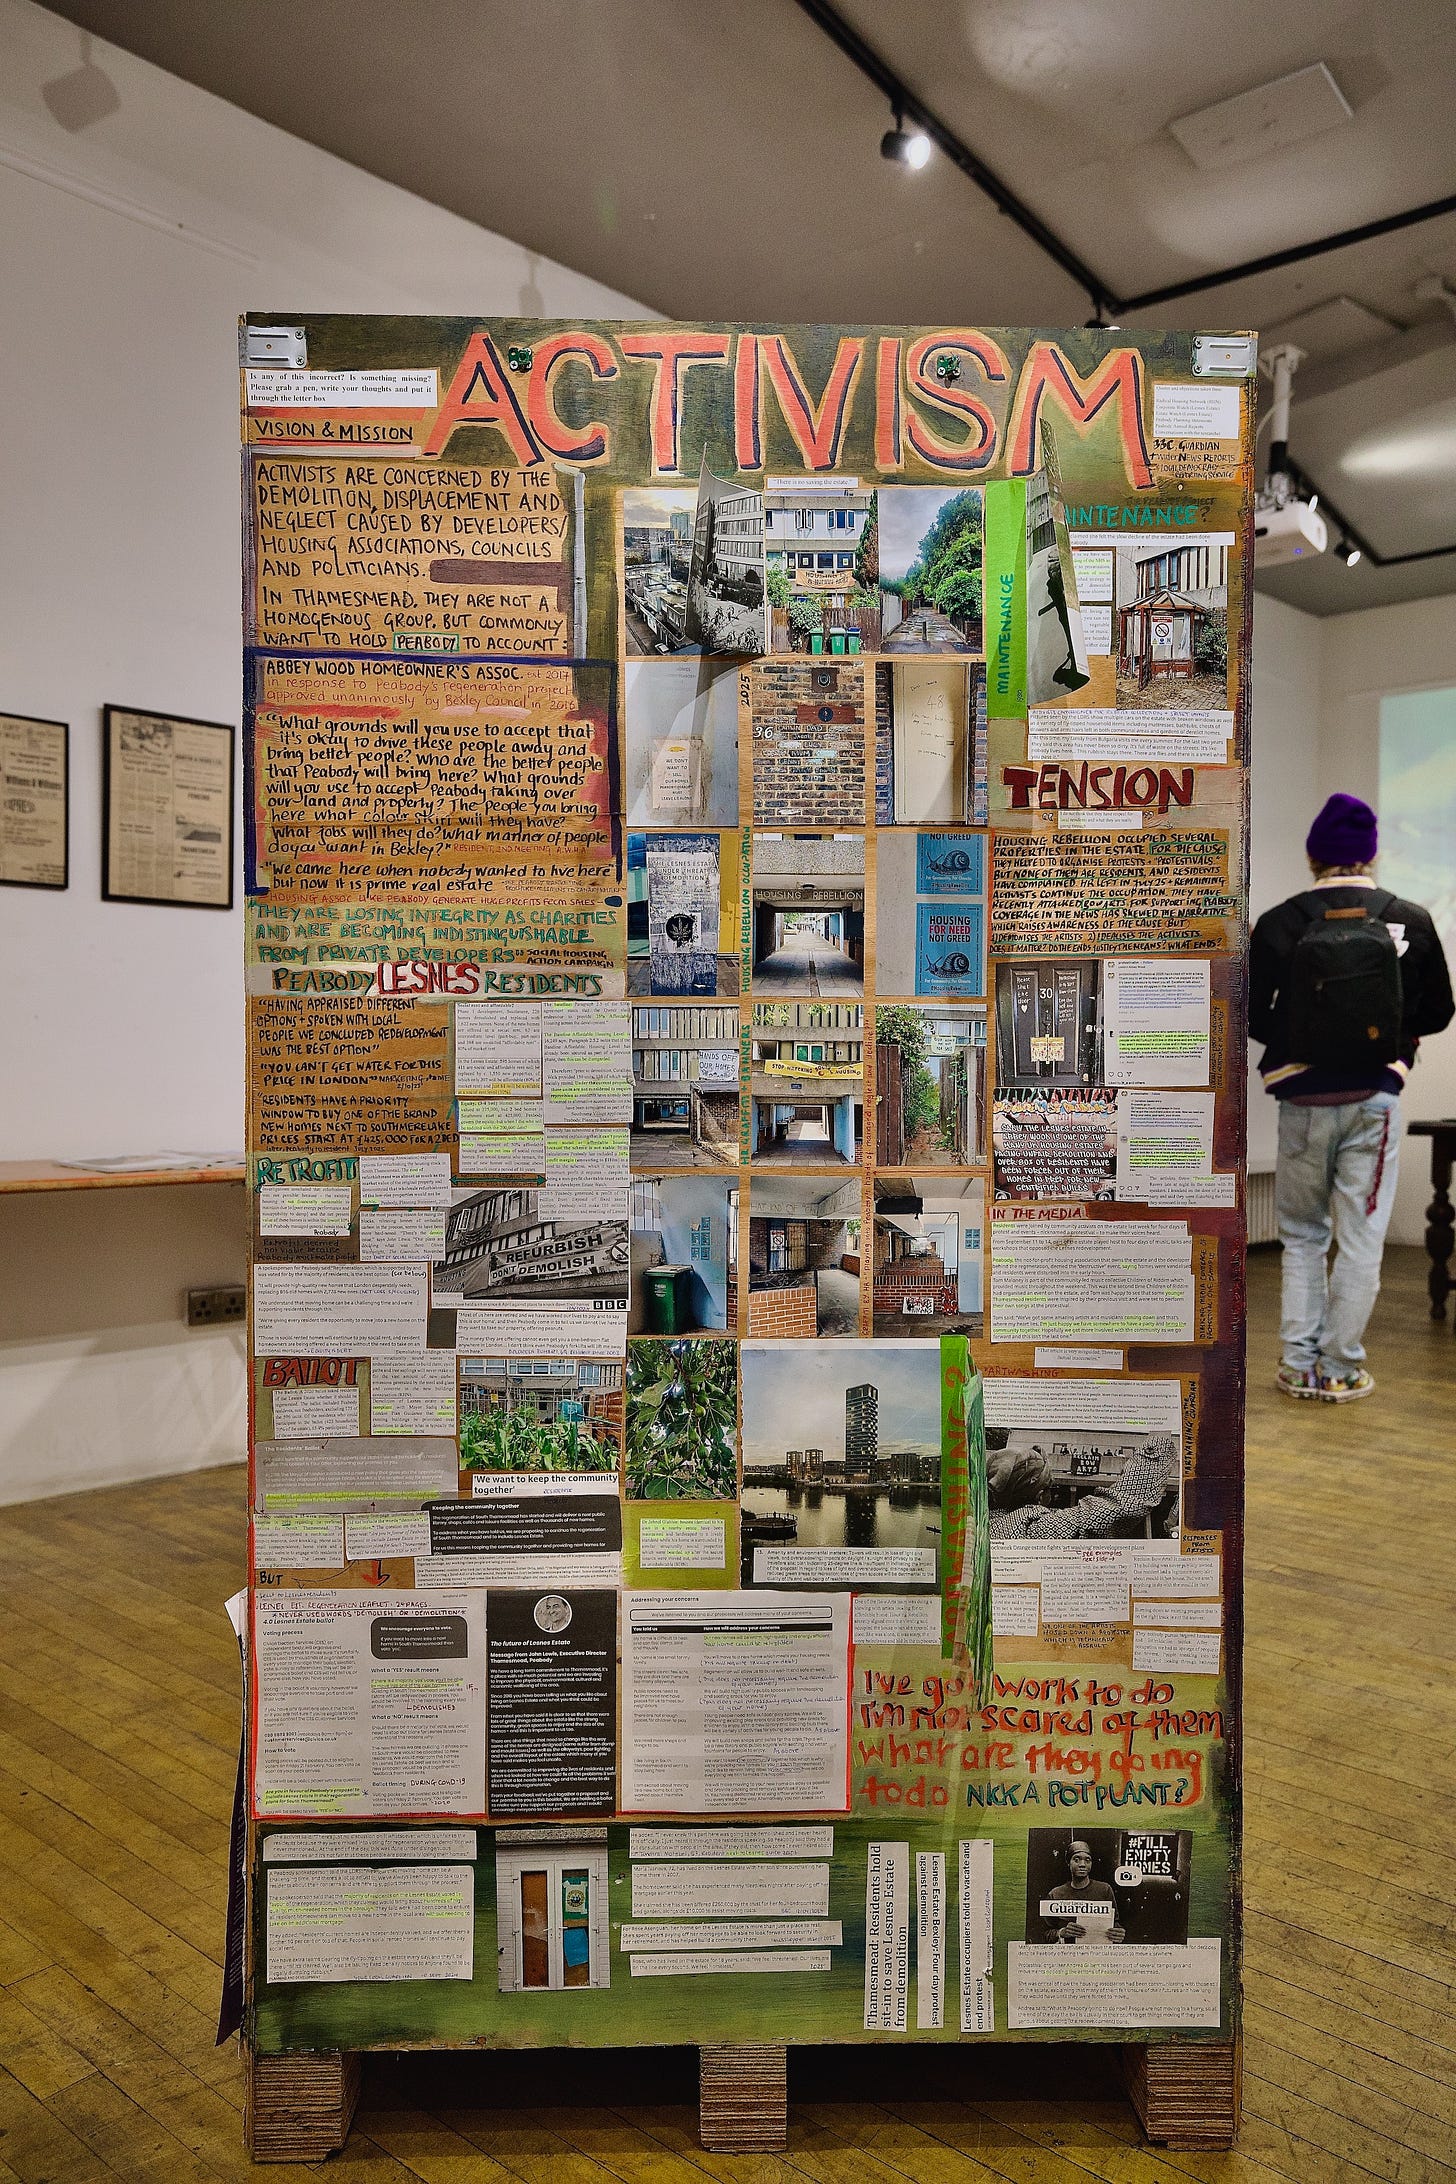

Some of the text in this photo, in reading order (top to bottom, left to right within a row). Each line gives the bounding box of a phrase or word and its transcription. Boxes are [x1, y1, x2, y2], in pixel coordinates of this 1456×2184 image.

[402, 375, 431, 383] missing?
[251, 394, 279, 402] through
[423, 332, 1156, 489] ACTIVISM
[255, 419, 413, 440] VISION & MISSION
[258, 463, 549, 488] ACTIVISTS ARE CONCERNED BY THE
[258, 485, 560, 511] DEMOLITION, DISPLACEMENT AND
[261, 535, 551, 557] HOUSING ASSOCIATIONS, COUNCILS
[996, 573, 1015, 695] MAINTENANCE
[267, 660, 523, 680] ABBEY WOOD HOMEOWNER'S ASSOC.
[740, 674, 750, 708] 2025
[753, 726, 773, 738] 36
[1004, 760, 1194, 815] TENSION
[994, 833, 1219, 847] HOUSING REBELLION OCCUPIED SEVERAL
[756, 890, 863, 901] HOUSING REBELLION
[305, 908, 339, 919] ARE
[346, 908, 404, 925] LOSING
[410, 908, 500, 926] INTEGRITY
[505, 910, 526, 923] AS
[530, 911, 616, 925] CHARITIES
[741, 889, 751, 944] REBELLION
[930, 916, 970, 925] HOUSING
[929, 925, 970, 934] FOR NEED
[929, 934, 970, 942] NOT GREED
[273, 961, 603, 997] PEABODY LESNES RESIDENTS
[741, 947, 751, 992] HOUSING
[1040, 988, 1053, 999] 30
[700, 1051, 738, 1062] HANDS OFF
[700, 1062, 714, 1070] OUR
[257, 1156, 359, 1185] RETROFIT
[992, 1207, 1082, 1219] IN THE MEDIA
[506, 1233, 603, 1263] REFURBISH
[492, 1256, 595, 1279] DON'T DEMOLISH
[593, 1300, 627, 1309] BBC
[263, 1358, 367, 1387] BALLOT
[474, 1475, 491, 1483] 'We
[528, 1475, 549, 1484] keep
[568, 1474, 617, 1484] community
[474, 1486, 514, 1495] together'
[259, 1571, 282, 1585] BUT
[865, 1670, 914, 1695] I've
[995, 1676, 1079, 1706] work
[1084, 1679, 1122, 1706] to
[1131, 1679, 1174, 1705] do
[861, 1701, 904, 1728] I'm
[982, 1705, 1092, 1735] scared
[1102, 1710, 1142, 1756] of
[1142, 1709, 1224, 1741] them
[858, 1734, 956, 1769] what
[961, 1744, 1015, 1771] are
[1025, 1741, 1101, 1781] they
[1024, 1781, 1040, 1805] A
[1049, 1780, 1097, 1807] POT
[1129, 1837, 1168, 1849] #FILL
[1126, 1850, 1171, 1861] EMPTY
[884, 1860, 894, 1898] Estate
[919, 1855, 927, 1937] against demolition
[1049, 1902, 1109, 1914] Guardian
[883, 1902, 893, 1944] Lesnes
[867, 1845, 881, 2026] Thamesmead: Residents hold
[931, 1855, 940, 2025] Lesnes Estate Bexley: Four day protest
[883, 1979, 892, 1991] to
[894, 1926, 907, 2027] from demolition
[882, 1995, 891, 2027] sit-in
